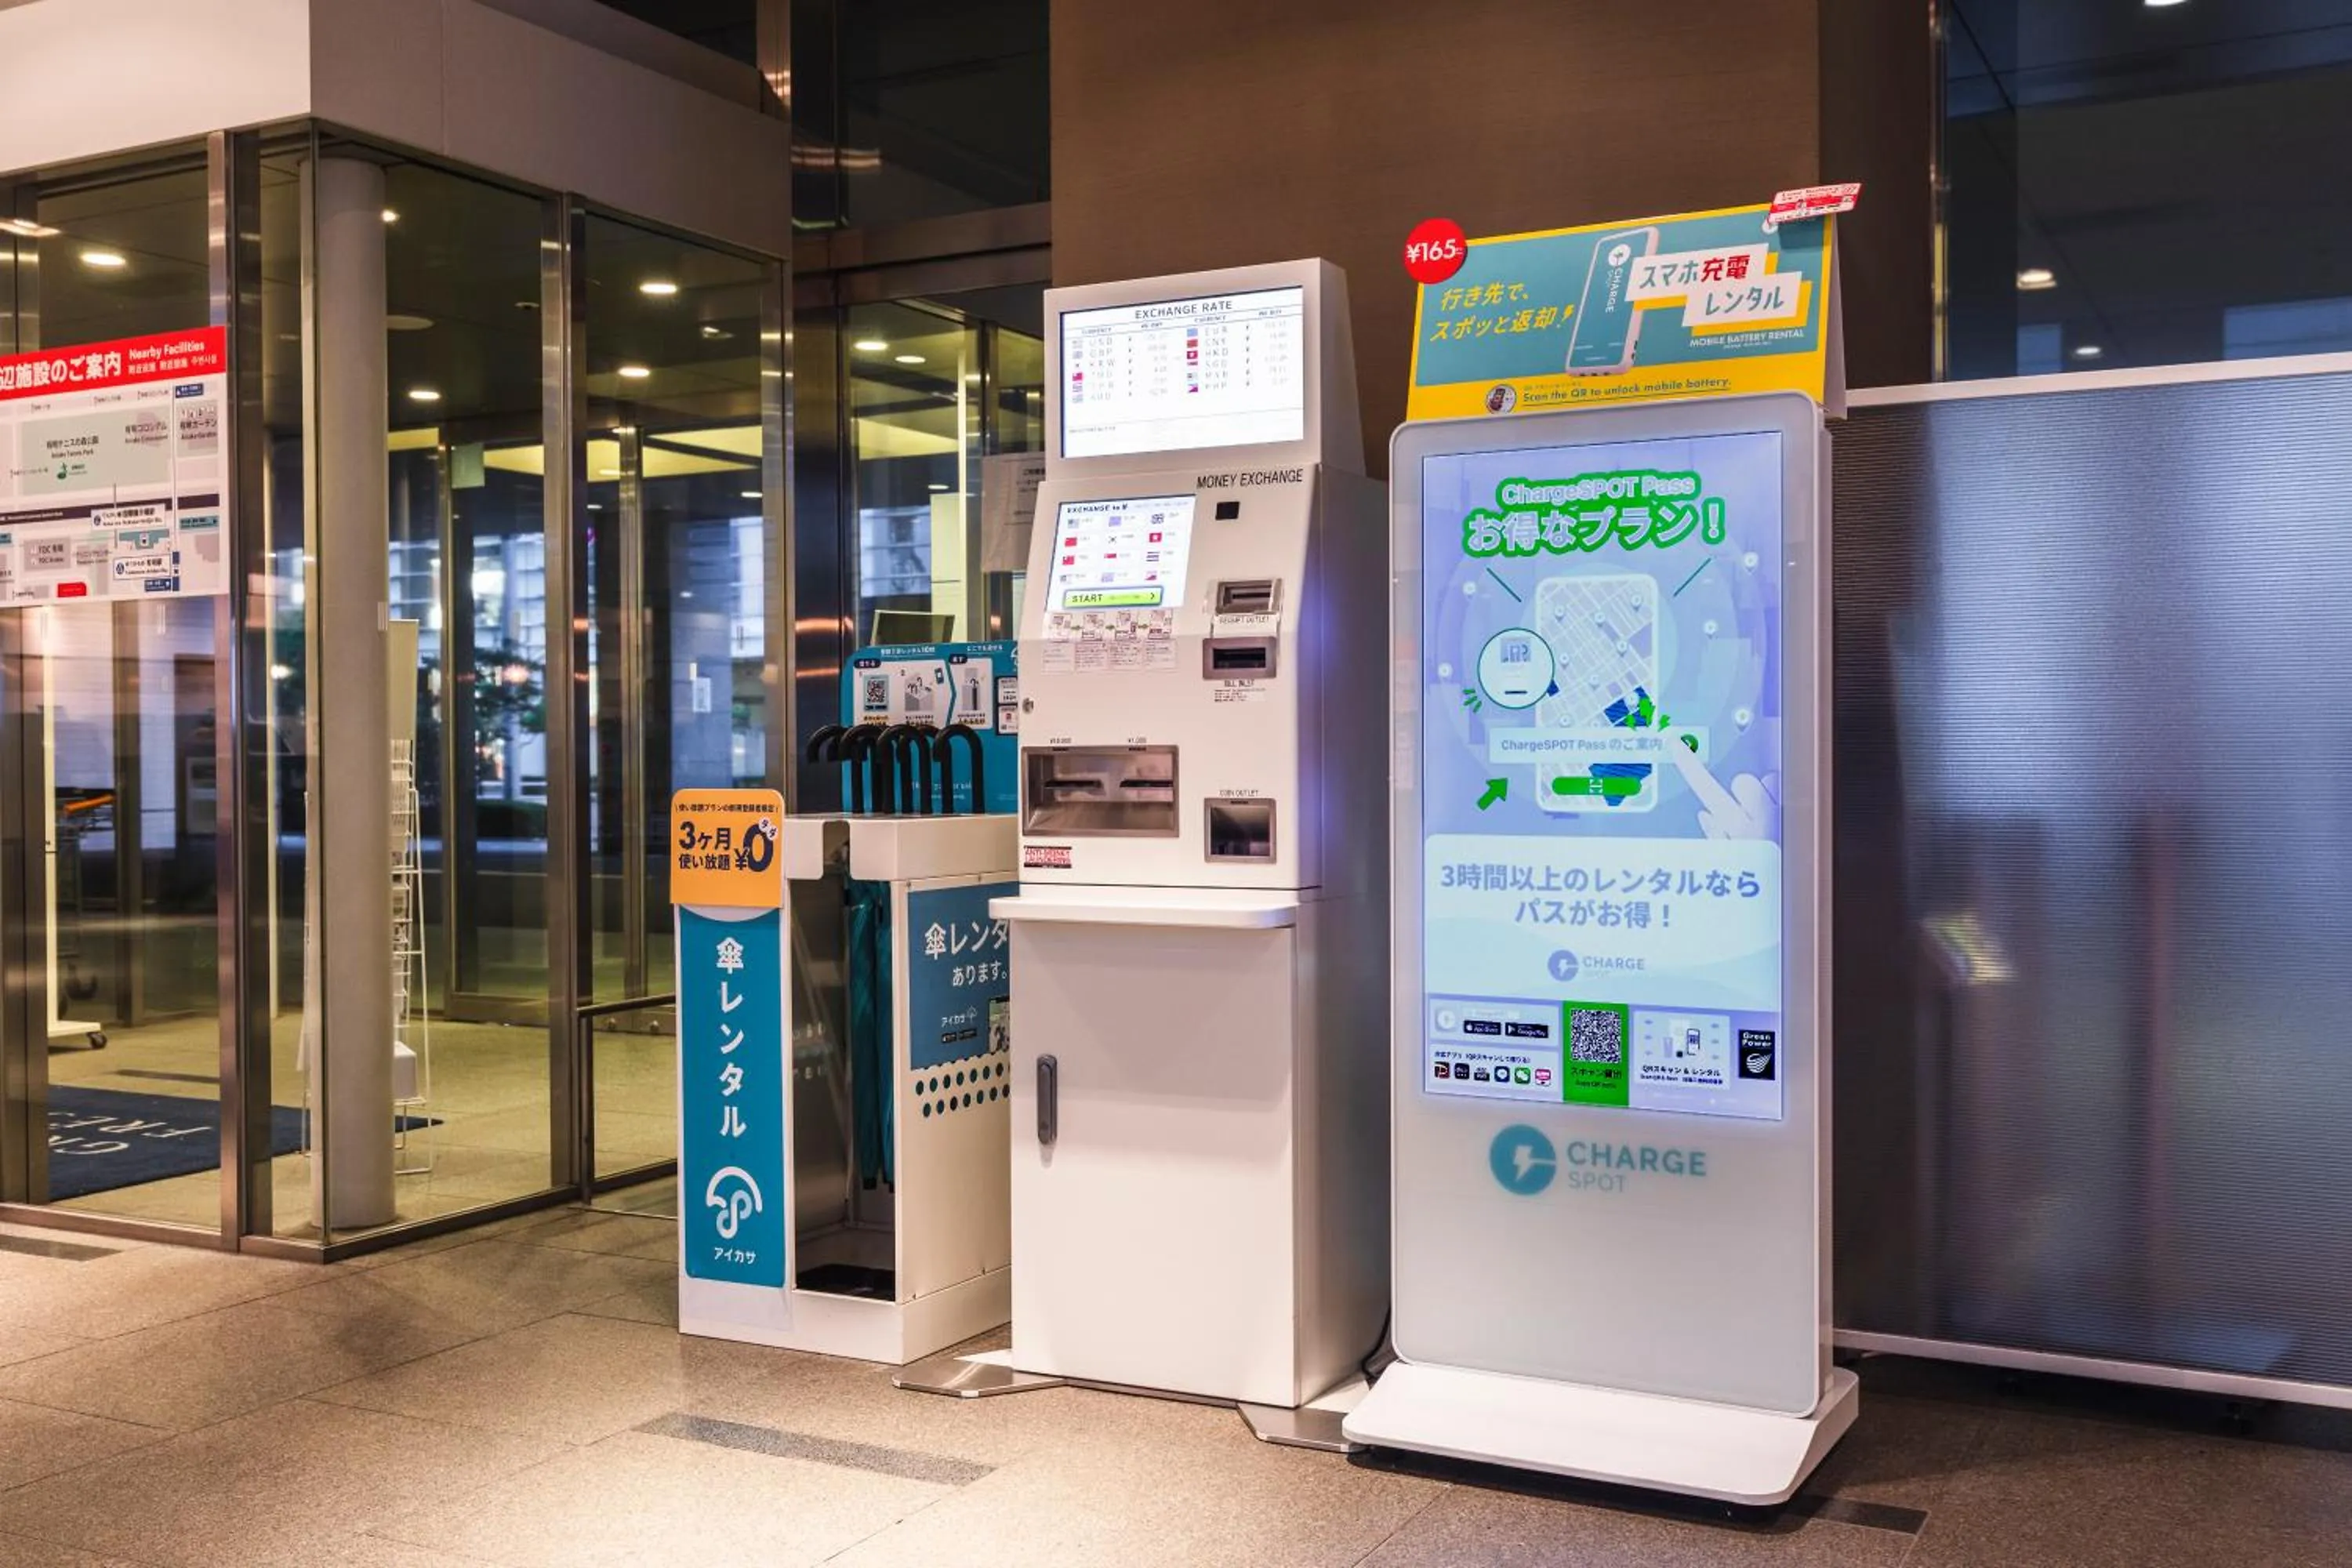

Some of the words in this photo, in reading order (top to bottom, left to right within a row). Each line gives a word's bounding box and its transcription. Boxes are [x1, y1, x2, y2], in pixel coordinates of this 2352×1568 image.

[1406, 238, 1456, 263] ¥165
[1639, 255, 1751, 289] スマホ充電
[1442, 282, 1529, 310] 行き先で、
[1606, 267, 1624, 313] CHARGE
[1705, 286, 1784, 315] レンタル
[1135, 304, 1198, 320] EXCHANGE
[1202, 300, 1233, 311] RATE
[129, 346, 162, 360] Nearby
[163, 340, 205, 355] Facilities
[1690, 335, 1725, 347] MOBILE
[1727, 332, 1767, 344] BATTERY
[1768, 328, 1804, 339] RENTAL
[1523, 392, 1548, 402] Scan
[1551, 389, 1567, 400] the
[1570, 387, 1588, 398] QR
[1591, 387, 1601, 397] to
[1604, 383, 1640, 395] unlock
[1645, 380, 1682, 392] mobile
[1686, 377, 1732, 390] battery.
[1196, 473, 1238, 489] MONEY
[1239, 469, 1304, 486] EXCHANGE
[1501, 477, 1639, 506] ChargeSPOT
[1642, 475, 1695, 497] Pass
[1067, 503, 1110, 514] EXCHANGE
[1468, 502, 1721, 552] お得なプラン！
[1072, 593, 1103, 603] START
[1501, 739, 1575, 753] ChargeSPOT
[1577, 739, 1606, 751] Pass
[679, 854, 731, 870] 使い放題
[1440, 864, 1761, 899] 3時間以上のレンタルなら
[1515, 900, 1670, 929] パスがお得！
[952, 960, 1008, 987] あります。
[1584, 956, 1645, 971] CHARGE
[716, 936, 747, 1138] 傘レンタル
[1743, 1032, 1771, 1040] Green
[1566, 1141, 1708, 1177] CHARGE
[1567, 1171, 1627, 1194] SPOT
[713, 1247, 757, 1265] アイカサ
